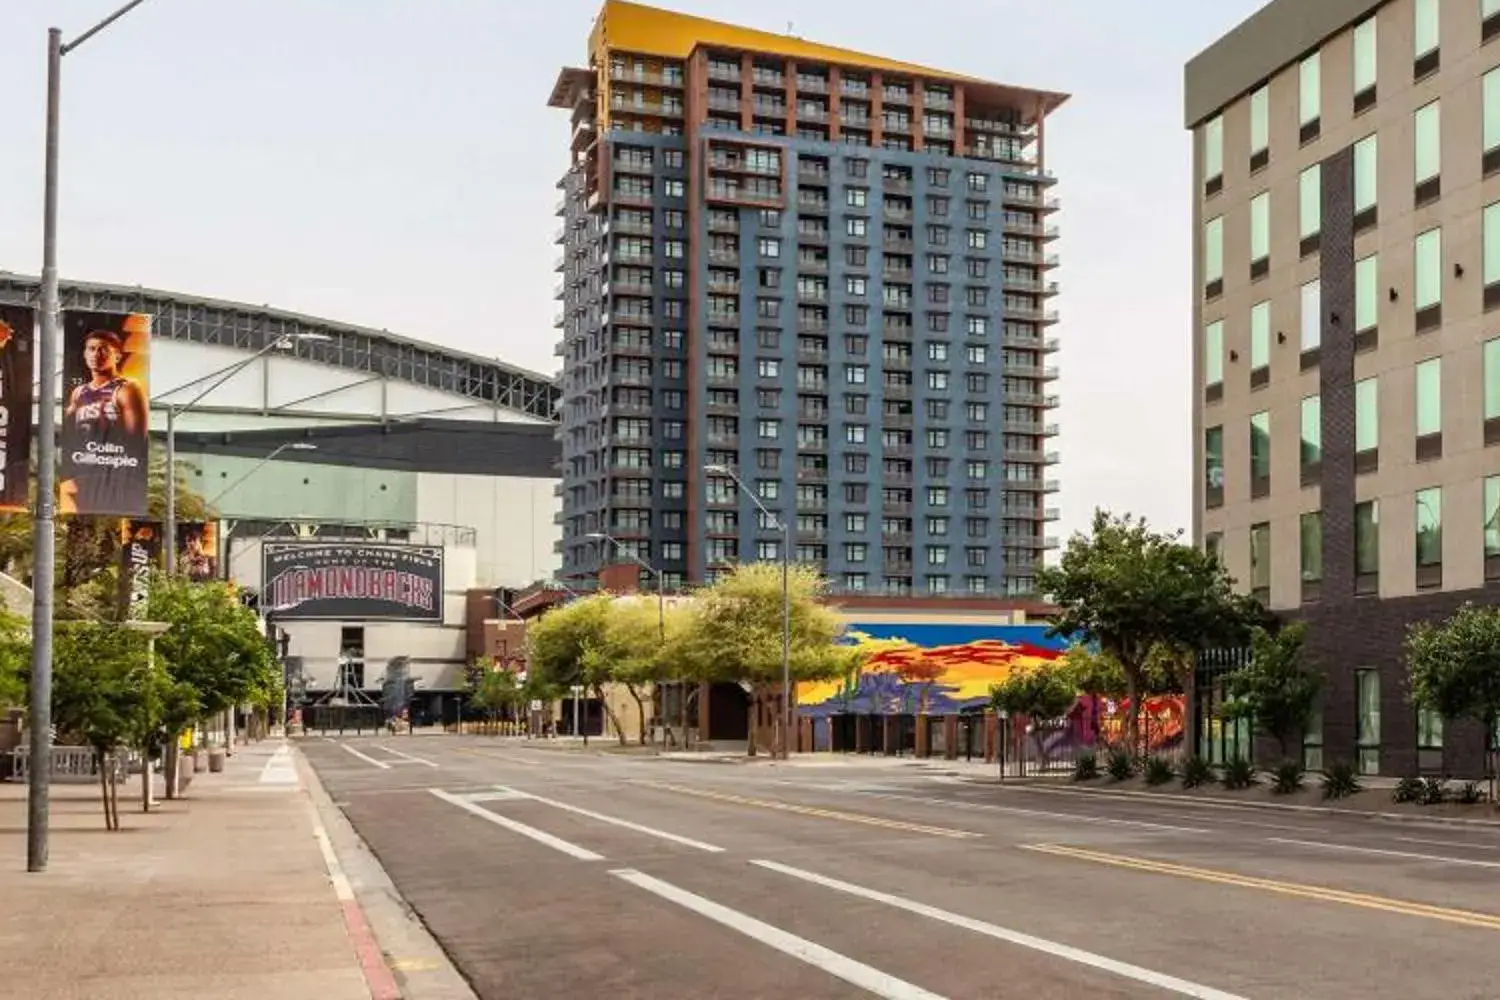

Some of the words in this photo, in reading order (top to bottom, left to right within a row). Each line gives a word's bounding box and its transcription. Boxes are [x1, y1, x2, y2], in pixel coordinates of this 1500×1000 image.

[86, 441, 124, 453] Collin
[72, 451, 138, 469] Gillespie
[273, 566, 433, 610] DIAMONDBACKS
